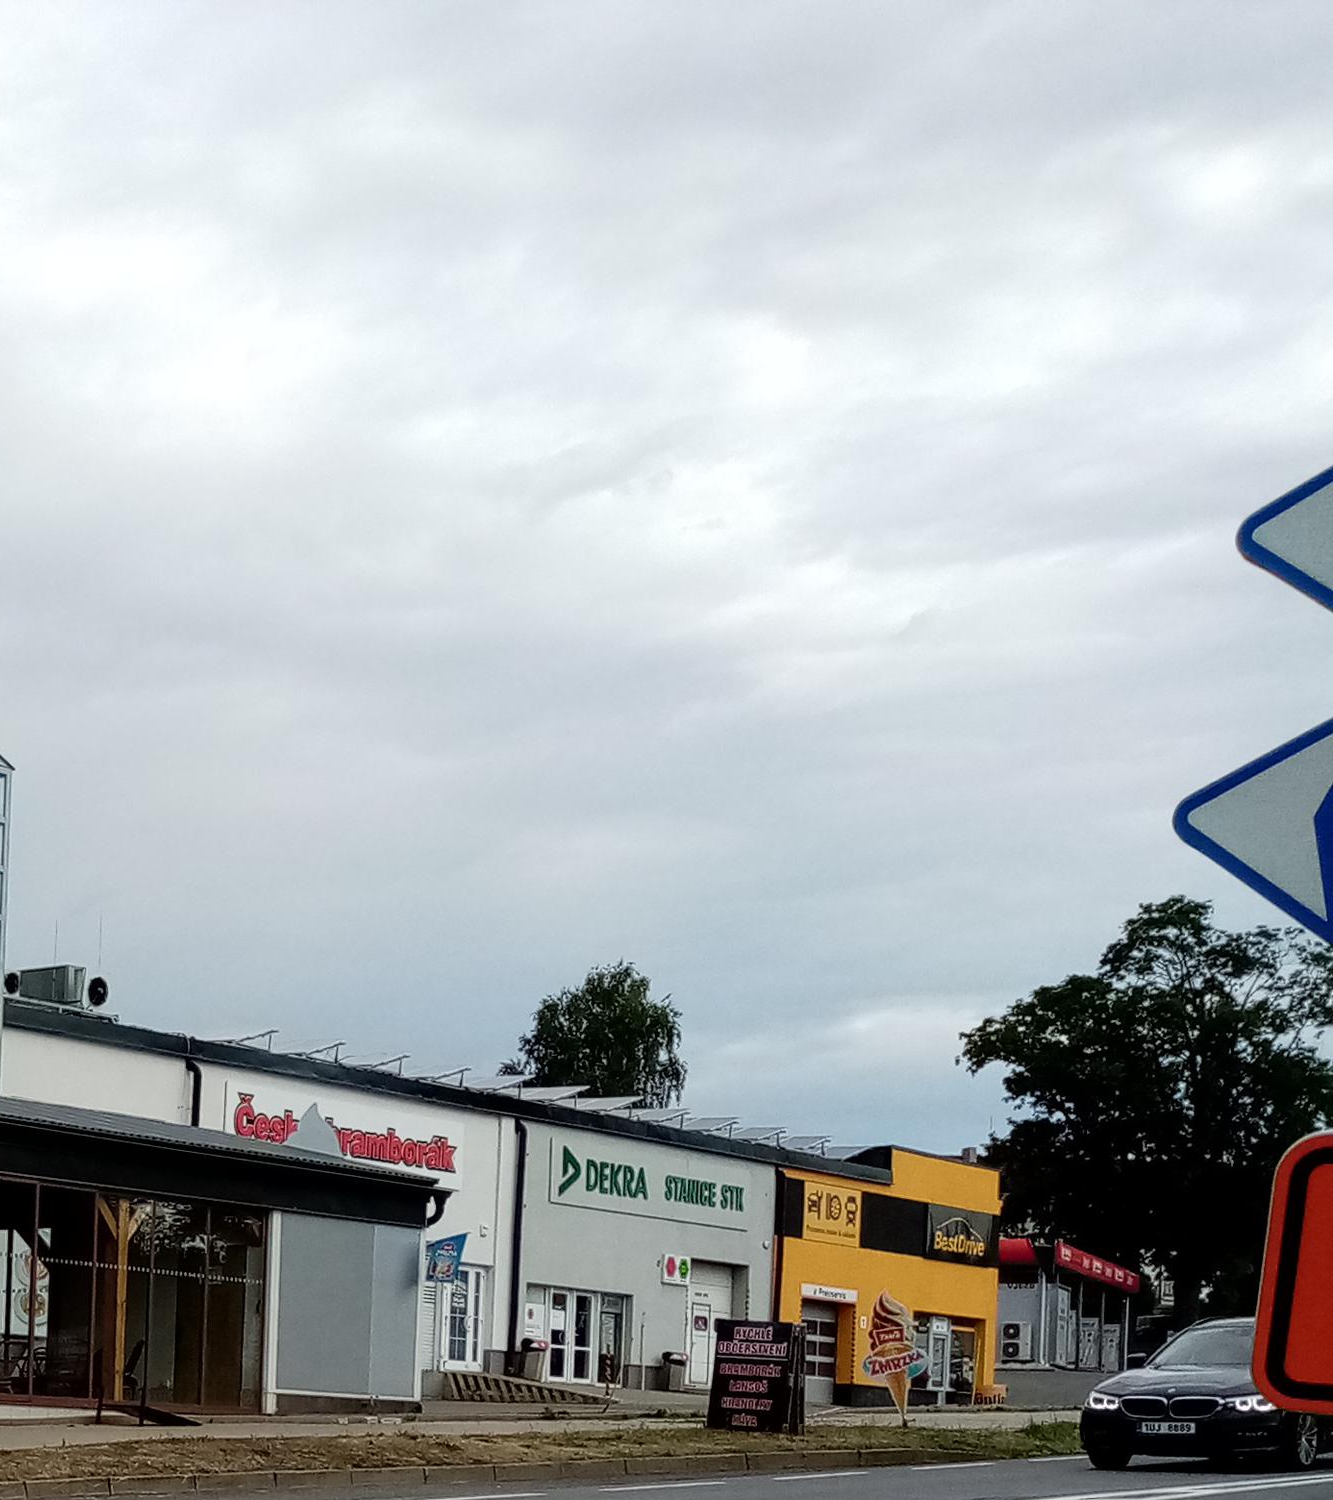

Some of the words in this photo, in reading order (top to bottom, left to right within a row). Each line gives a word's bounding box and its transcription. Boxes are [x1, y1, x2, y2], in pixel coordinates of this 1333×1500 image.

[234, 1092, 300, 1144] Česk
[324, 1117, 457, 1174] ramborák
[585, 1158, 648, 1200] DEKRA
[664, 1175, 717, 1208] STANICE
[720, 1184, 744, 1212] STK
[933, 1231, 985, 1257] BestDrive
[734, 1326, 774, 1340] RYCHLÉ
[717, 1340, 788, 1357] OBČERSTVENÍ
[719, 1363, 782, 1378] BRAMBORÁK
[868, 1350, 925, 1377] ZMRZKA
